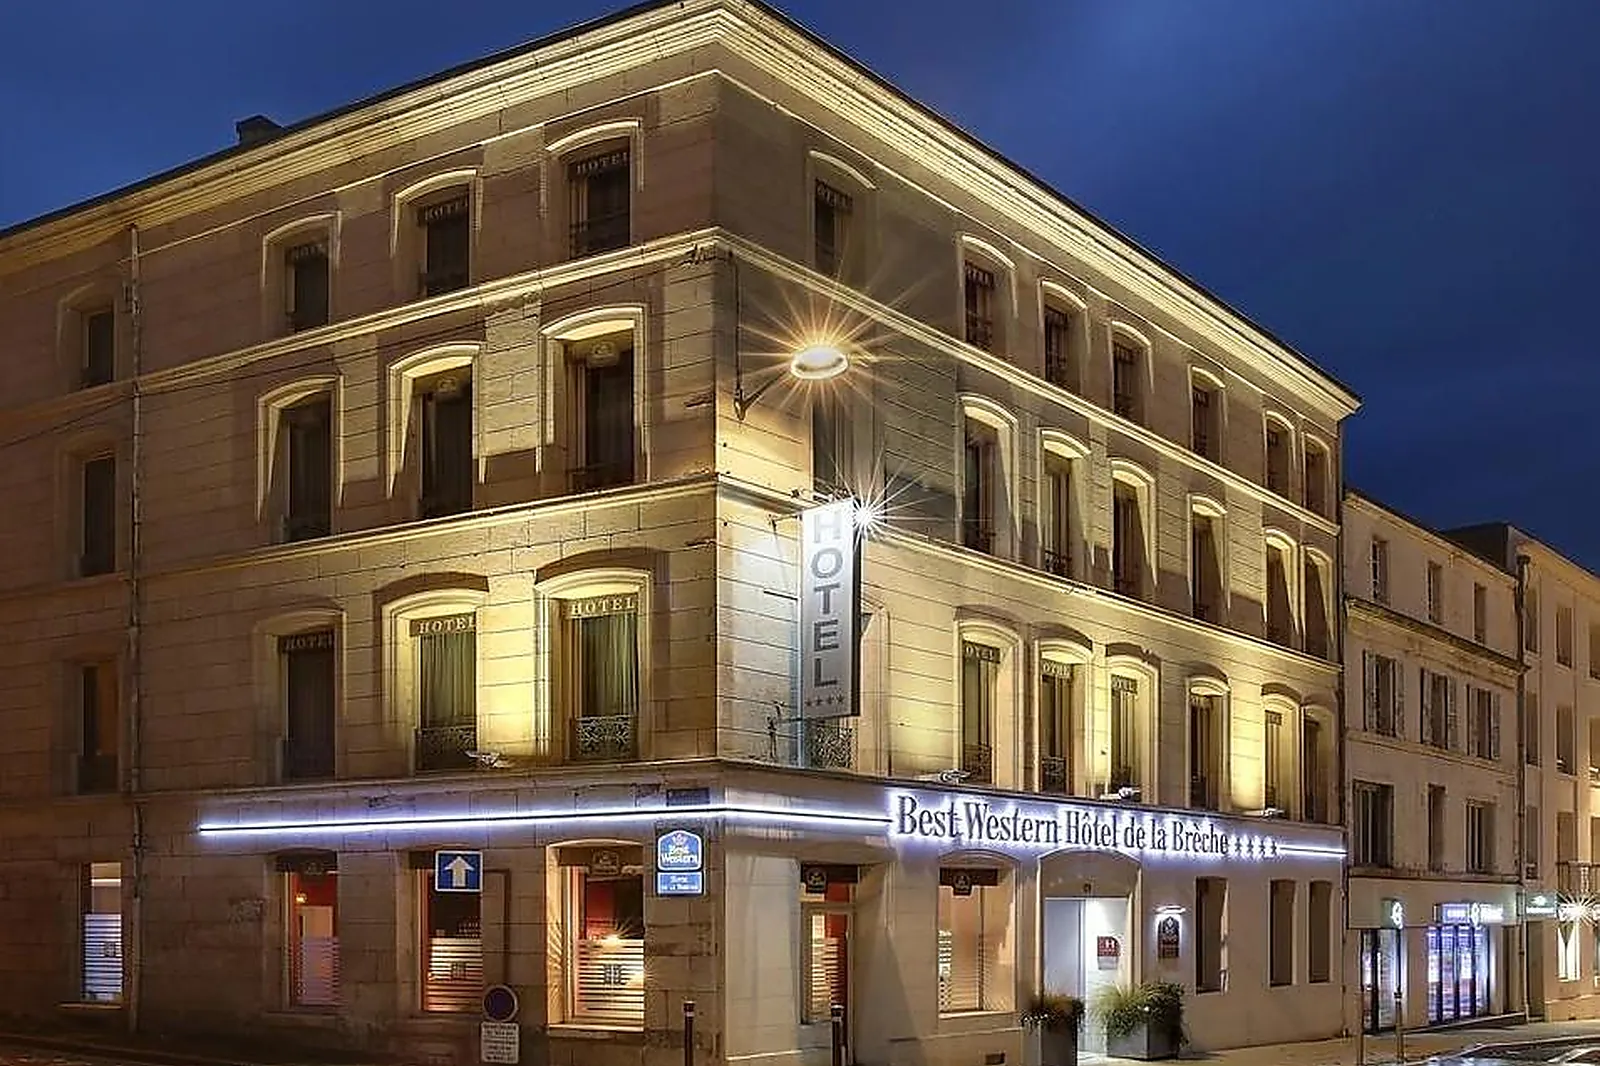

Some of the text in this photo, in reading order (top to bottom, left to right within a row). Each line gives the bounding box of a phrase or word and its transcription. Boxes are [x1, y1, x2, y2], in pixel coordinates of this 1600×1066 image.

[570, 597, 635, 615] HOTEL
[810, 510, 843, 687] HOTEL
[418, 616, 477, 634] HOTEL
[896, 795, 1229, 855] Best Western Hôtel de la Brèche
